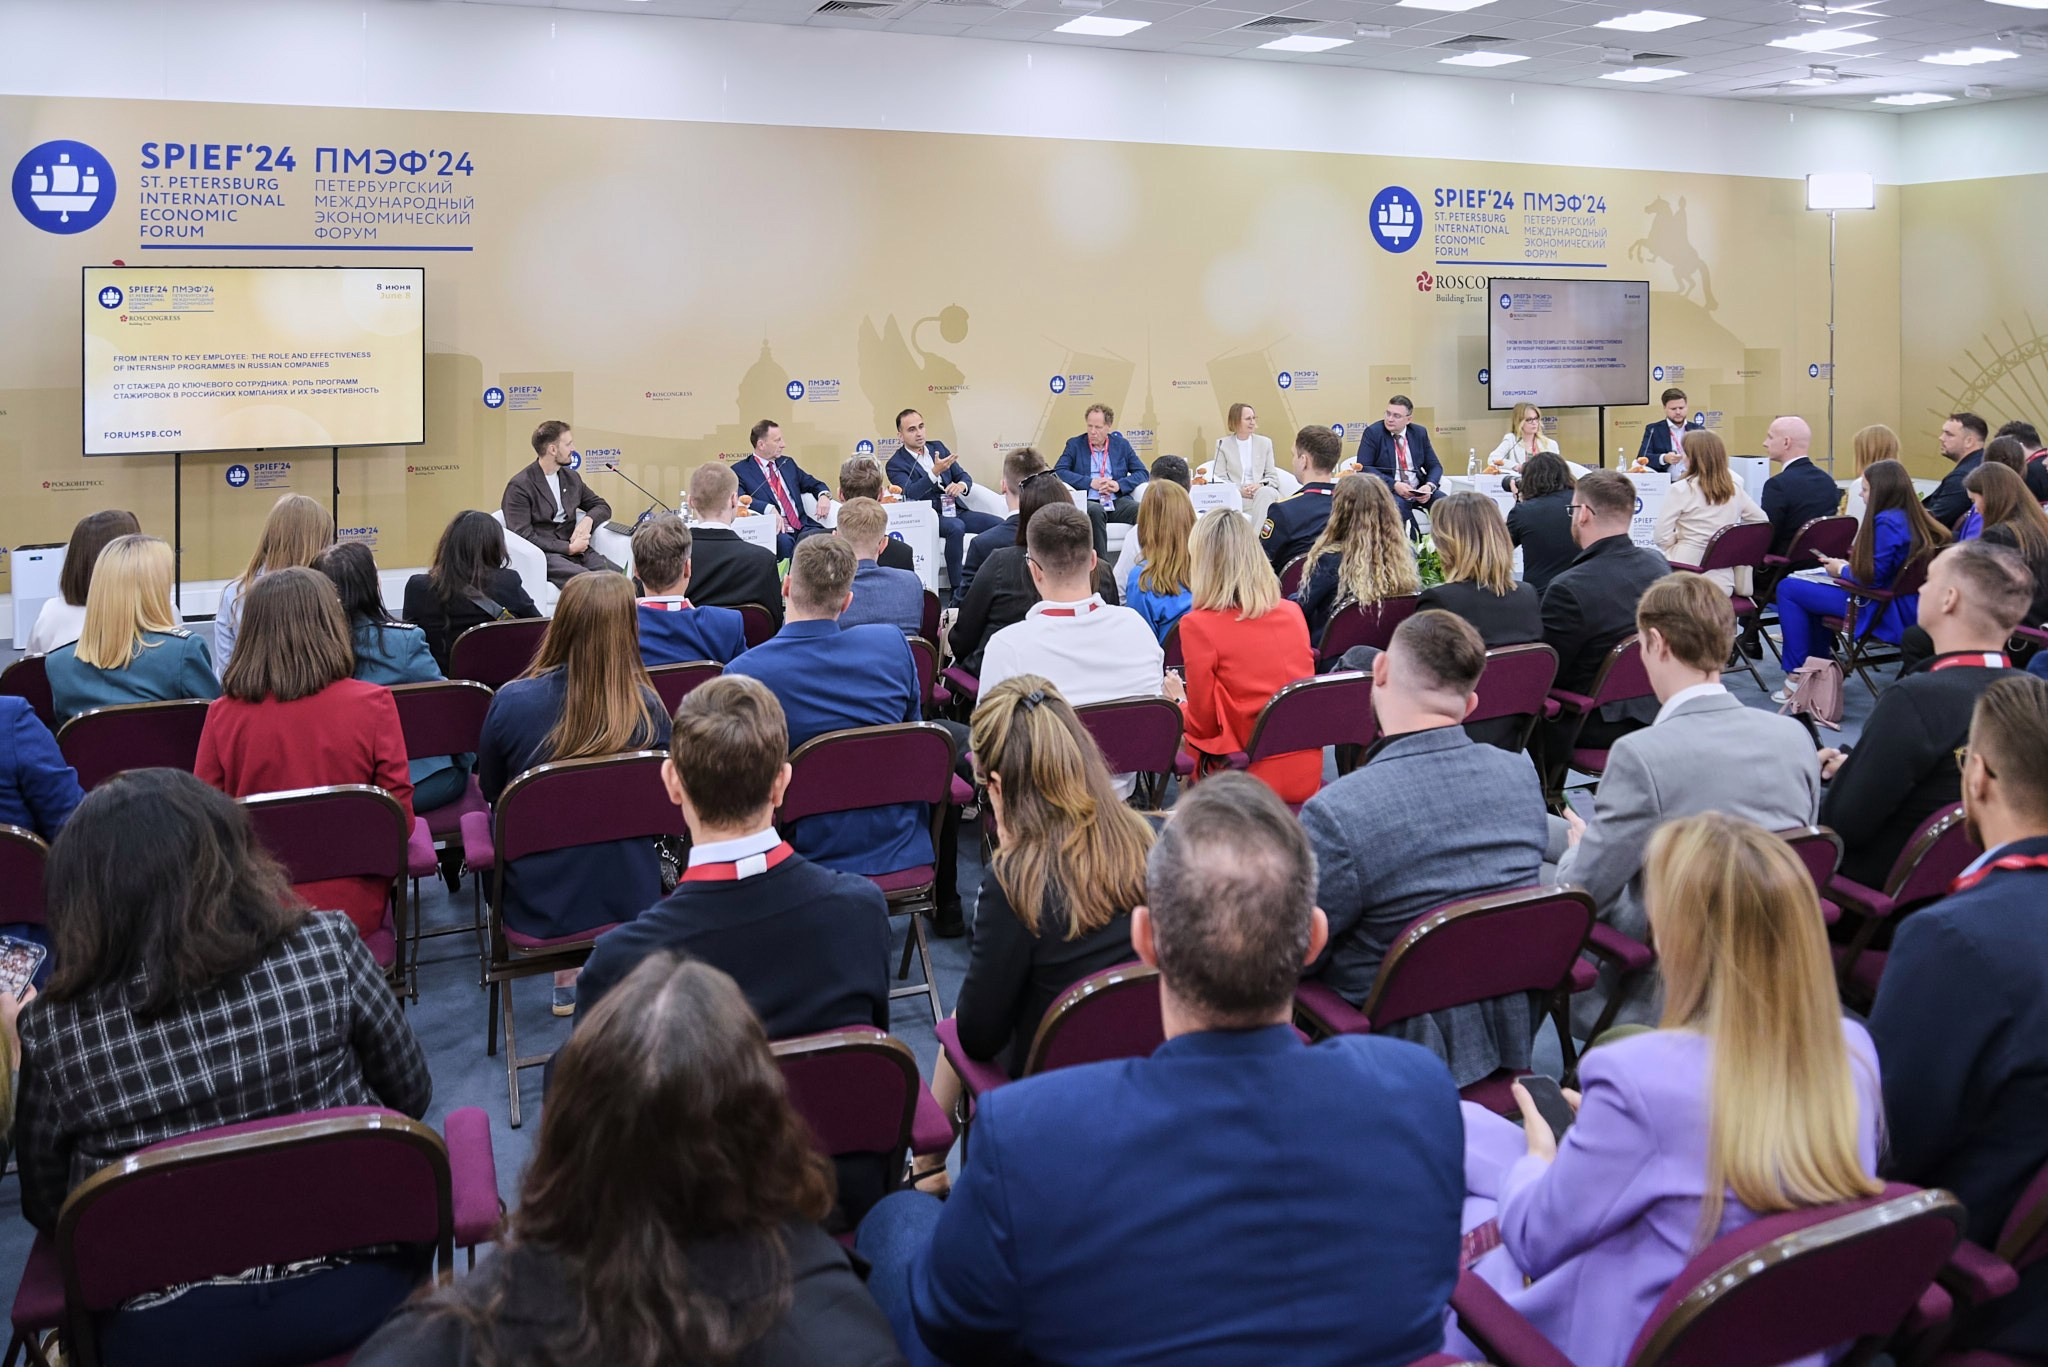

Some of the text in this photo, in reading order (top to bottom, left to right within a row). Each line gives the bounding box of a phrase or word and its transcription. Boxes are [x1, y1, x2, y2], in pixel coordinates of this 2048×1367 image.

[140, 142, 297, 172] SPIEF'24
[315, 147, 475, 177] ПМЭФ'24
[140, 176, 279, 191] ST. PETERSBURG
[315, 177, 453, 194] ПЕТЕРБУРГСКИЙ
[140, 192, 286, 207] INTERNATIONAL
[315, 194, 475, 210] МЕЖДУНАРОДНЫЙ
[1434, 188, 1515, 210] SPIEF'24
[1523, 192, 1607, 214] ПМЭФ'24
[140, 208, 238, 222] ECONOMIC
[314, 210, 471, 225] ЭКОНОМИЧЕСКИЙ
[1434, 212, 1506, 223] ST. PETERSBURG
[1523, 214, 1596, 226] ПЕТЕРБУРГСКИЙ
[140, 225, 205, 238] FORUM
[314, 226, 378, 240] ФОРУМ
[1434, 223, 1510, 235] INTERNATIONAL
[1524, 226, 1608, 238] МЕЖДУНАРОДНЫЙ
[1435, 235, 1486, 245] ECONOMIC
[1524, 237, 1606, 249] ЭКОНОМИЧЕСКИЙ
[1435, 246, 1469, 256] FORUM
[1524, 249, 1558, 259] ФОРУМ
[128, 285, 168, 294] SPIEF'24
[172, 285, 214, 293] ПМЭФ'24
[377, 283, 383, 291] 8
[1436, 293, 1465, 304] Building
[203, 353, 248, 361] EMPLOYEE:
[291, 352, 308, 360] AND
[168, 382, 181, 390] ДО
[183, 381, 234, 389] КЛЮЧЕВОГО
[235, 380, 291, 388] СОТРУДНИКА:
[293, 379, 313, 387] РОЛЬ
[315, 378, 358, 386] ПРОГРАММ
[508, 386, 542, 394] SPIEF'24
[181, 390, 236, 398] РОССИЙСКИХ
[238, 389, 288, 397] КОМПАНИЯХ
[310, 387, 379, 395] ЭФФЕКТИВНОСТЬ
[104, 430, 182, 439] FORUMSPB.COM
[585, 448, 621, 456] ПМЭФ'24
[254, 462, 291, 471] SPIEF'24
[339, 527, 379, 536] ПМЭФ'24
